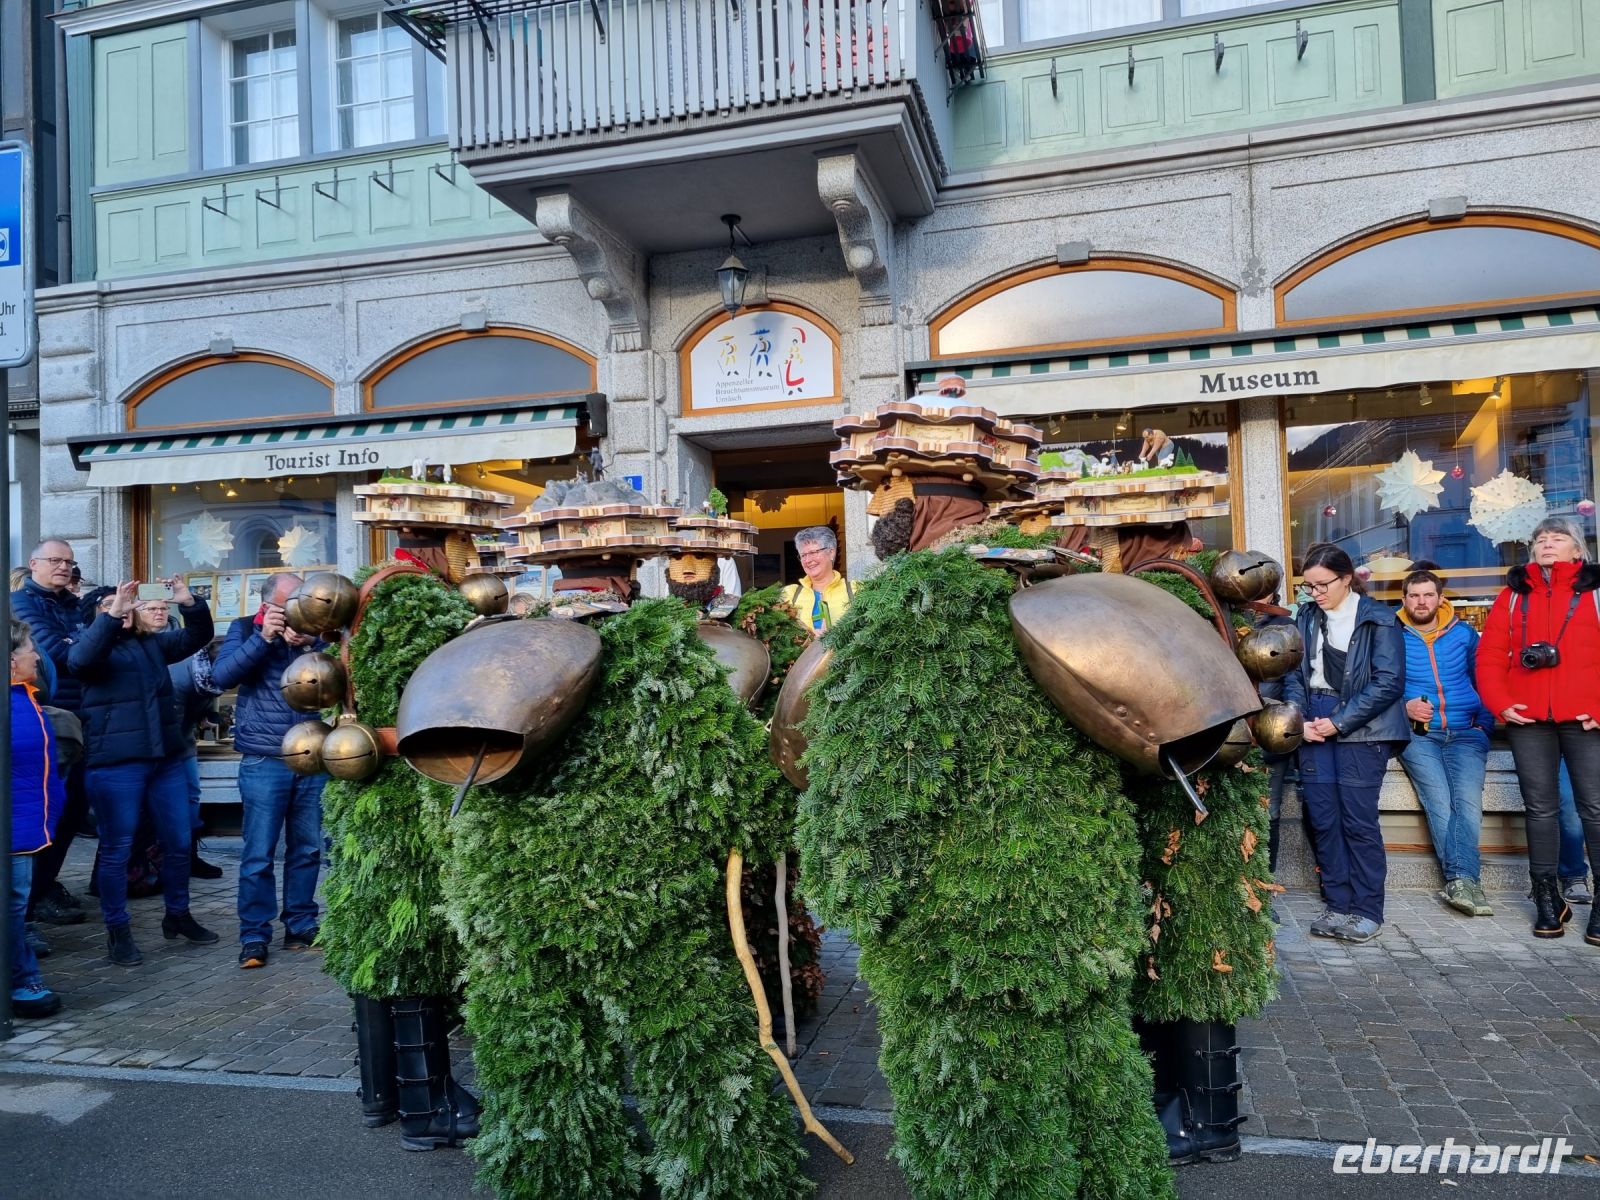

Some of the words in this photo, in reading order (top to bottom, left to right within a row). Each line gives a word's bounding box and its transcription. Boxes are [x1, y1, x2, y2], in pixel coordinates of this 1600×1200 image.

[715, 378, 754, 388] Appenzeller
[715, 384, 780, 395] Brauchtumsmuseum
[1200, 370, 1320, 394] Museum
[265, 452, 330, 471] Tourist
[337, 447, 380, 466] Info
